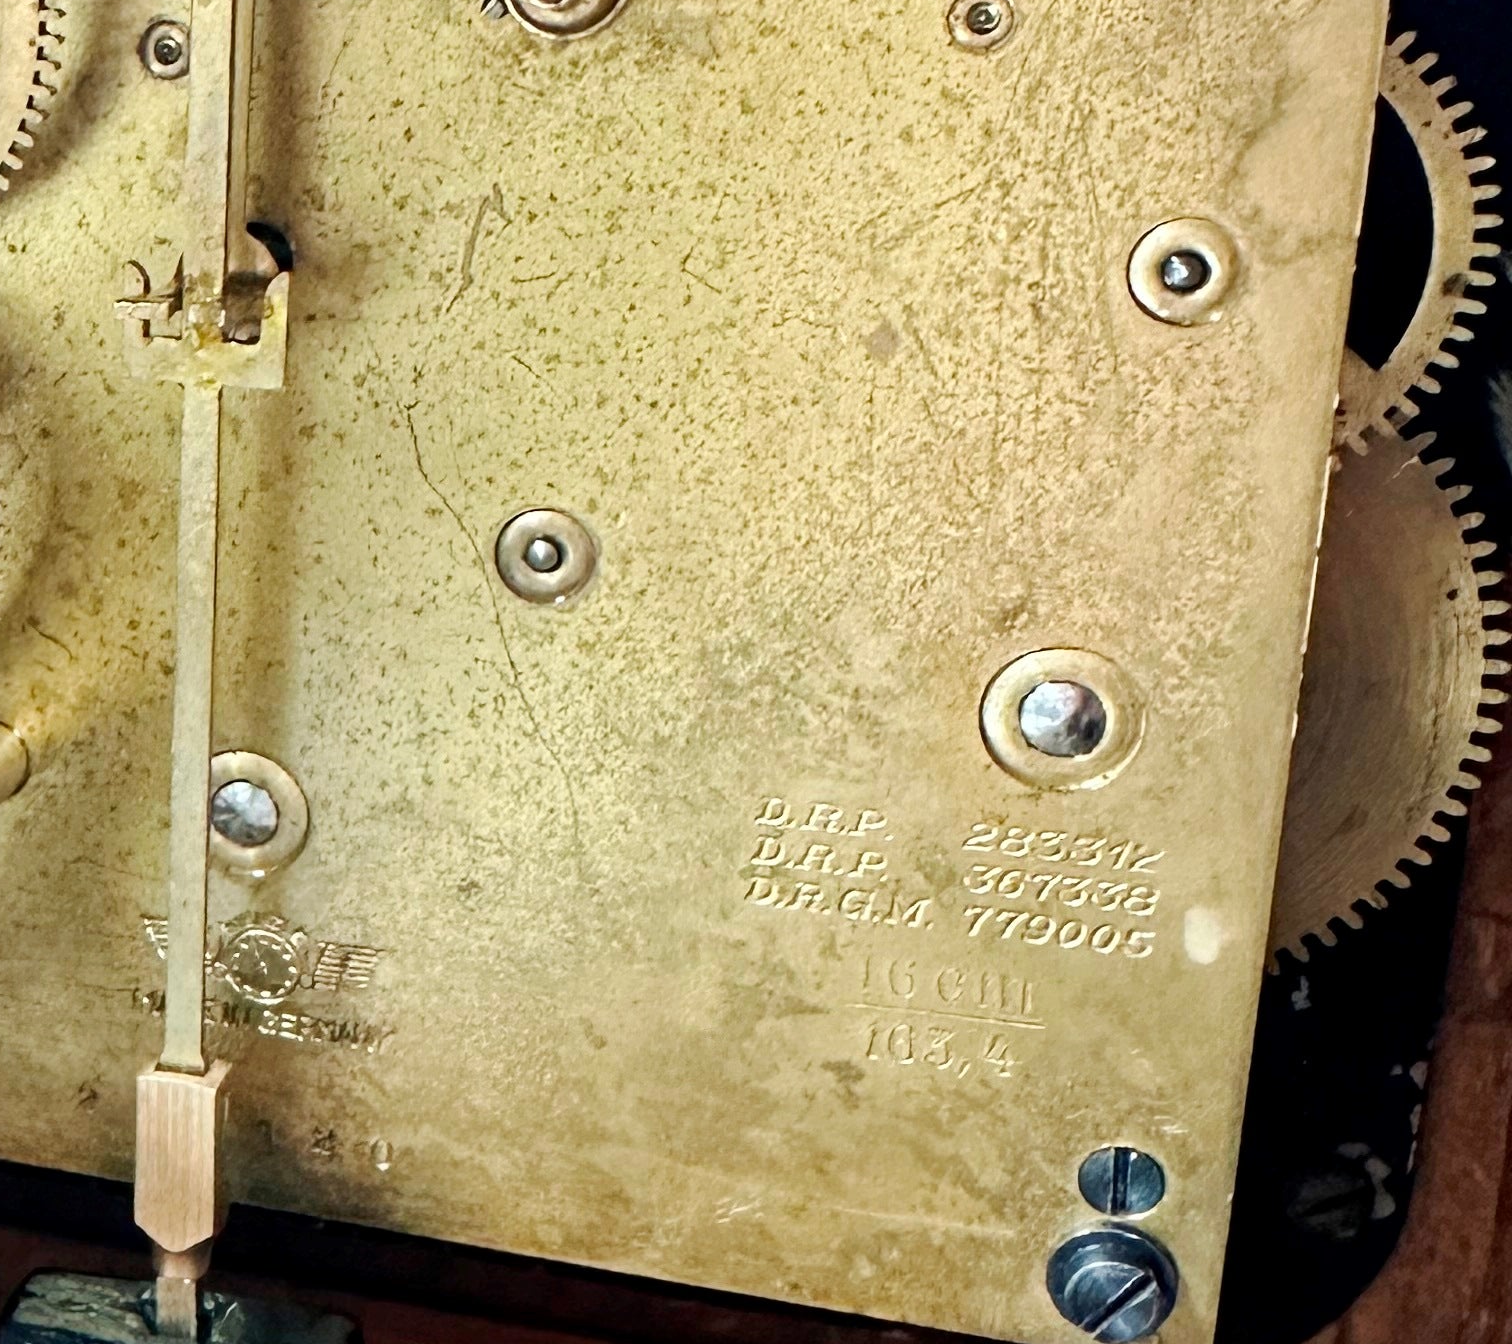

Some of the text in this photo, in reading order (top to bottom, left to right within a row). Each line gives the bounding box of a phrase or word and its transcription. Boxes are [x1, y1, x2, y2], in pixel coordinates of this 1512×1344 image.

[754, 794, 895, 841] D.R.P.
[750, 835, 1162, 917] D.R.P. 367338
[743, 875, 1157, 959] D.R.G.M. 779005
[257, 1008, 395, 1052] GERMANY
